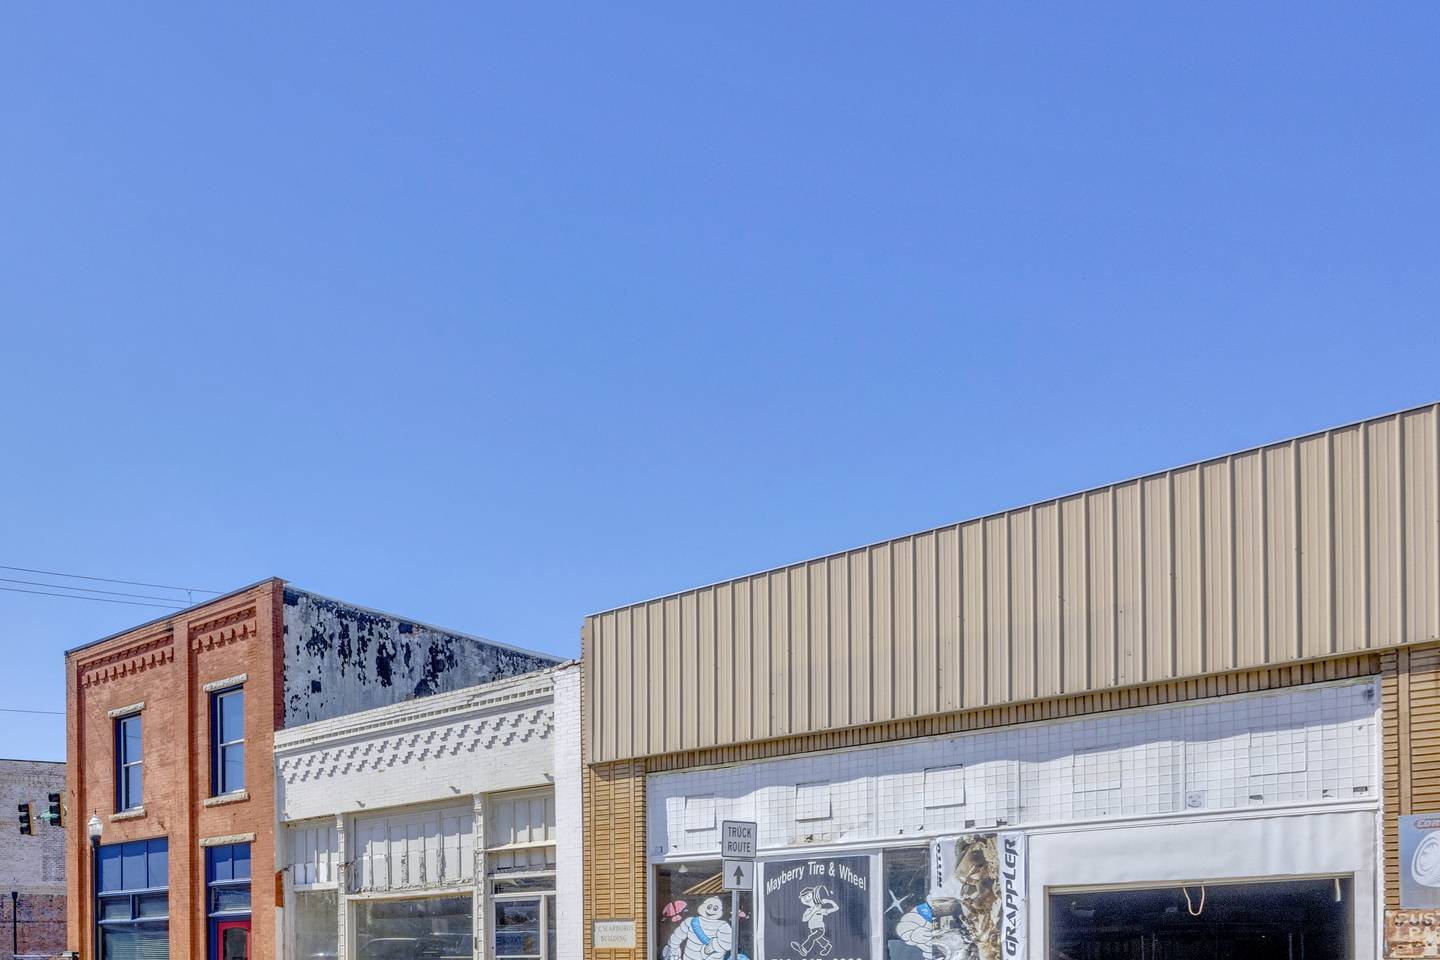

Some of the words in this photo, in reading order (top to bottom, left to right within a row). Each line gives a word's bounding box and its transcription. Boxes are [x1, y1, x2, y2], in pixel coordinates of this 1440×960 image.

[728, 826, 752, 838] TRUCK
[727, 841, 751, 852] ROUTE
[766, 866, 805, 895] Mayberry
[808, 861, 825, 875] Tire
[828, 862, 835, 877] &
[839, 864, 866, 891] Wheel
[1002, 839, 1019, 957] GRAPPLER
